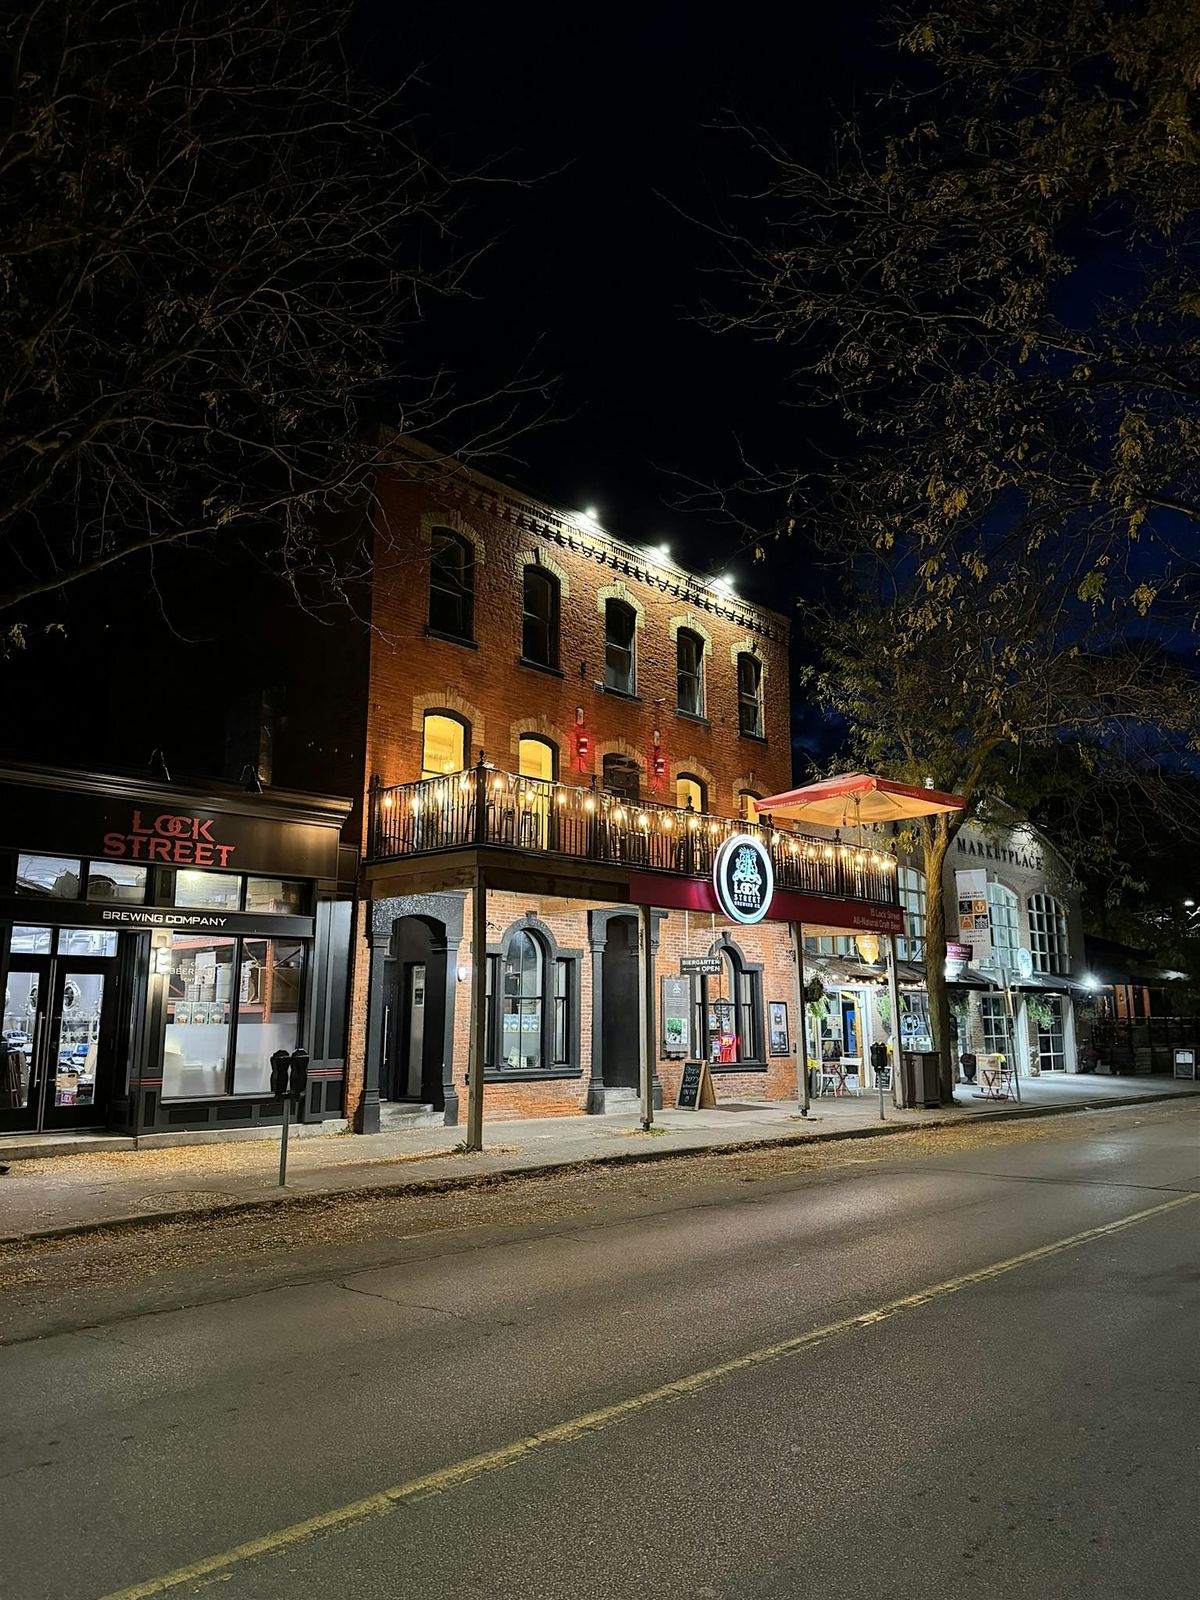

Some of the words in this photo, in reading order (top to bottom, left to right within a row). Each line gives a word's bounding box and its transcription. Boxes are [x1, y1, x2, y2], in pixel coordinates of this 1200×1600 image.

[131, 810, 215, 842] LOCK
[102, 832, 236, 867] STREET
[957, 837, 1043, 870] MARKETPLACE
[733, 880, 761, 896] LOCK
[733, 893, 761, 904] STREET
[102, 910, 163, 923] BREWING
[166, 914, 227, 926] COMPANY
[875, 909, 887, 919] Lock
[886, 911, 901, 921] Street
[879, 919, 890, 929] Craft
